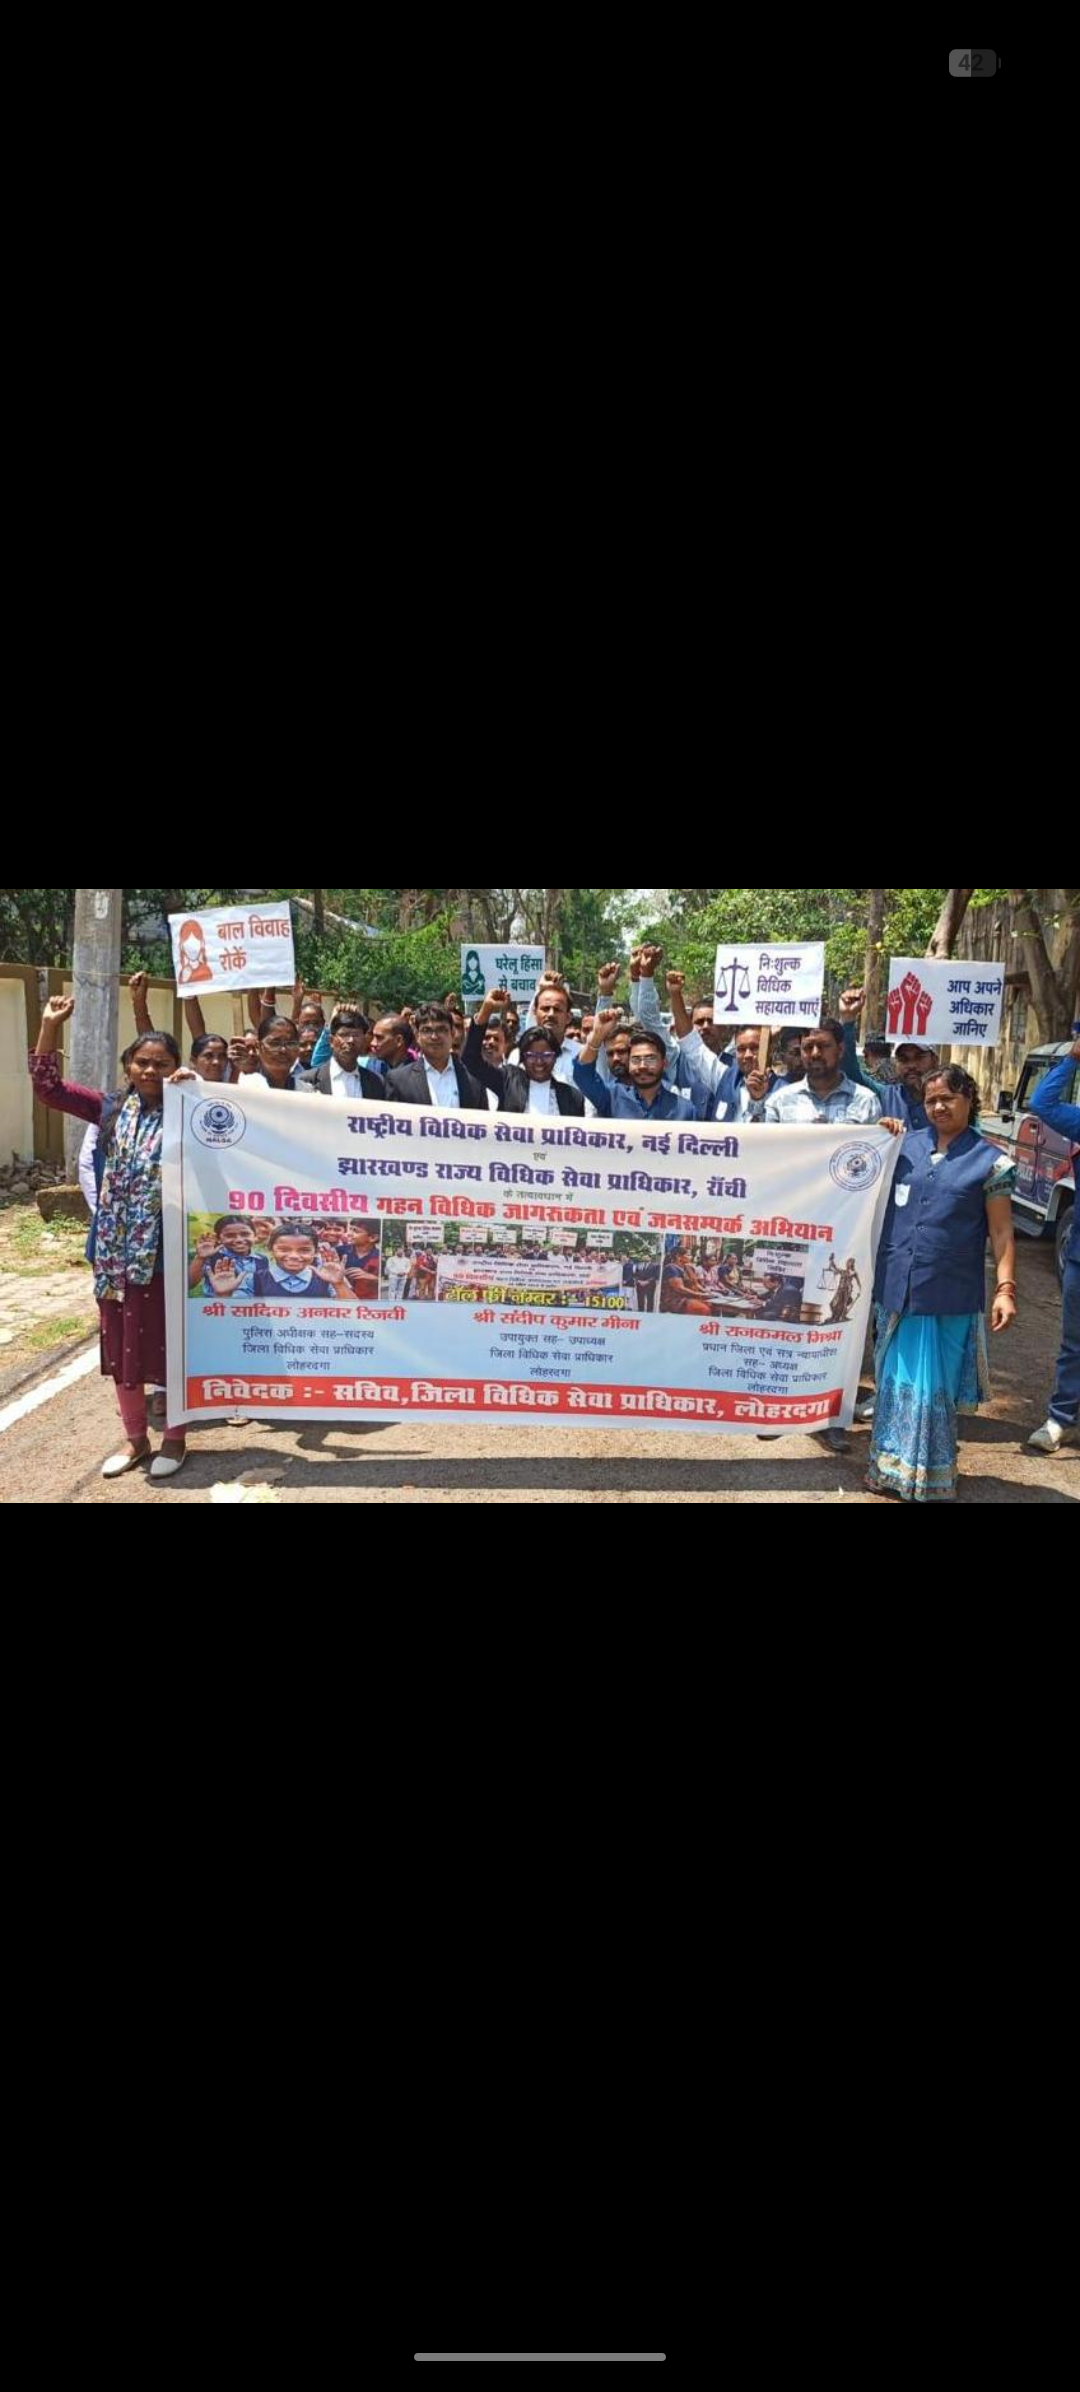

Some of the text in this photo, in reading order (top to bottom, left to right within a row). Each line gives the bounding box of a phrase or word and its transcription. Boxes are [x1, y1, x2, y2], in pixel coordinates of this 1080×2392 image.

[216, 914, 290, 941] बाल विवाह
[218, 946, 247, 971] रोकें
[495, 954, 543, 974] घरेलू हिंसा
[498, 975, 536, 991] से बचाव
[757, 976, 792, 993] विधिक
[947, 978, 1002, 995] आप अपने
[755, 1000, 795, 1016] सहायता
[949, 997, 995, 1016] अधिकार
[953, 1019, 988, 1037] जानिए
[347, 1113, 739, 1158] राष्ट्रीय विधिक सेवा प्राधिकार, नई दिल्ली
[337, 1157, 428, 1178] झारखण्ड
[436, 1162, 482, 1182] राज्य
[489, 1162, 554, 1185] विधिक
[562, 1166, 600, 1188] सेवा
[607, 1170, 698, 1198] प्राधिकार,
[275, 1186, 368, 1212] दिवसीय
[377, 1196, 423, 1216] गहन
[430, 1195, 496, 1218] विधिक
[613, 1206, 642, 1228] एवं
[649, 1210, 745, 1233] जनसम्पर्क
[750, 1215, 833, 1242] अभियान
[585, 1296, 625, 1308] 15100
[202, 1302, 406, 1321] श्री सादिक अनवर रिजवी
[473, 1309, 641, 1330] श्री संदीप कुमार मीना
[243, 1325, 272, 1340] पुलिस
[699, 1321, 719, 1335] श्री
[725, 1325, 803, 1343] राजकमल
[242, 1341, 375, 1355] जिला विधिक सेवा प्राधिकार
[490, 1346, 614, 1363] जिला विधिक सेवा प्राधिकार
[702, 1342, 727, 1352] प्रधान
[731, 1342, 755, 1355] जिला
[287, 1359, 331, 1371] लोहरदगा
[530, 1366, 571, 1378] लोहरदगा
[708, 1364, 827, 1383] जिला विधिक सेवा प्राधिकार
[747, 1382, 789, 1395] लोहरदगा
[202, 1378, 294, 1400] निवेदक
[483, 1383, 560, 1406] विधिक
[568, 1386, 613, 1409] सेवा
[620, 1389, 724, 1417] प्राधिकार,
[734, 1397, 830, 1418] लोहरदगा
